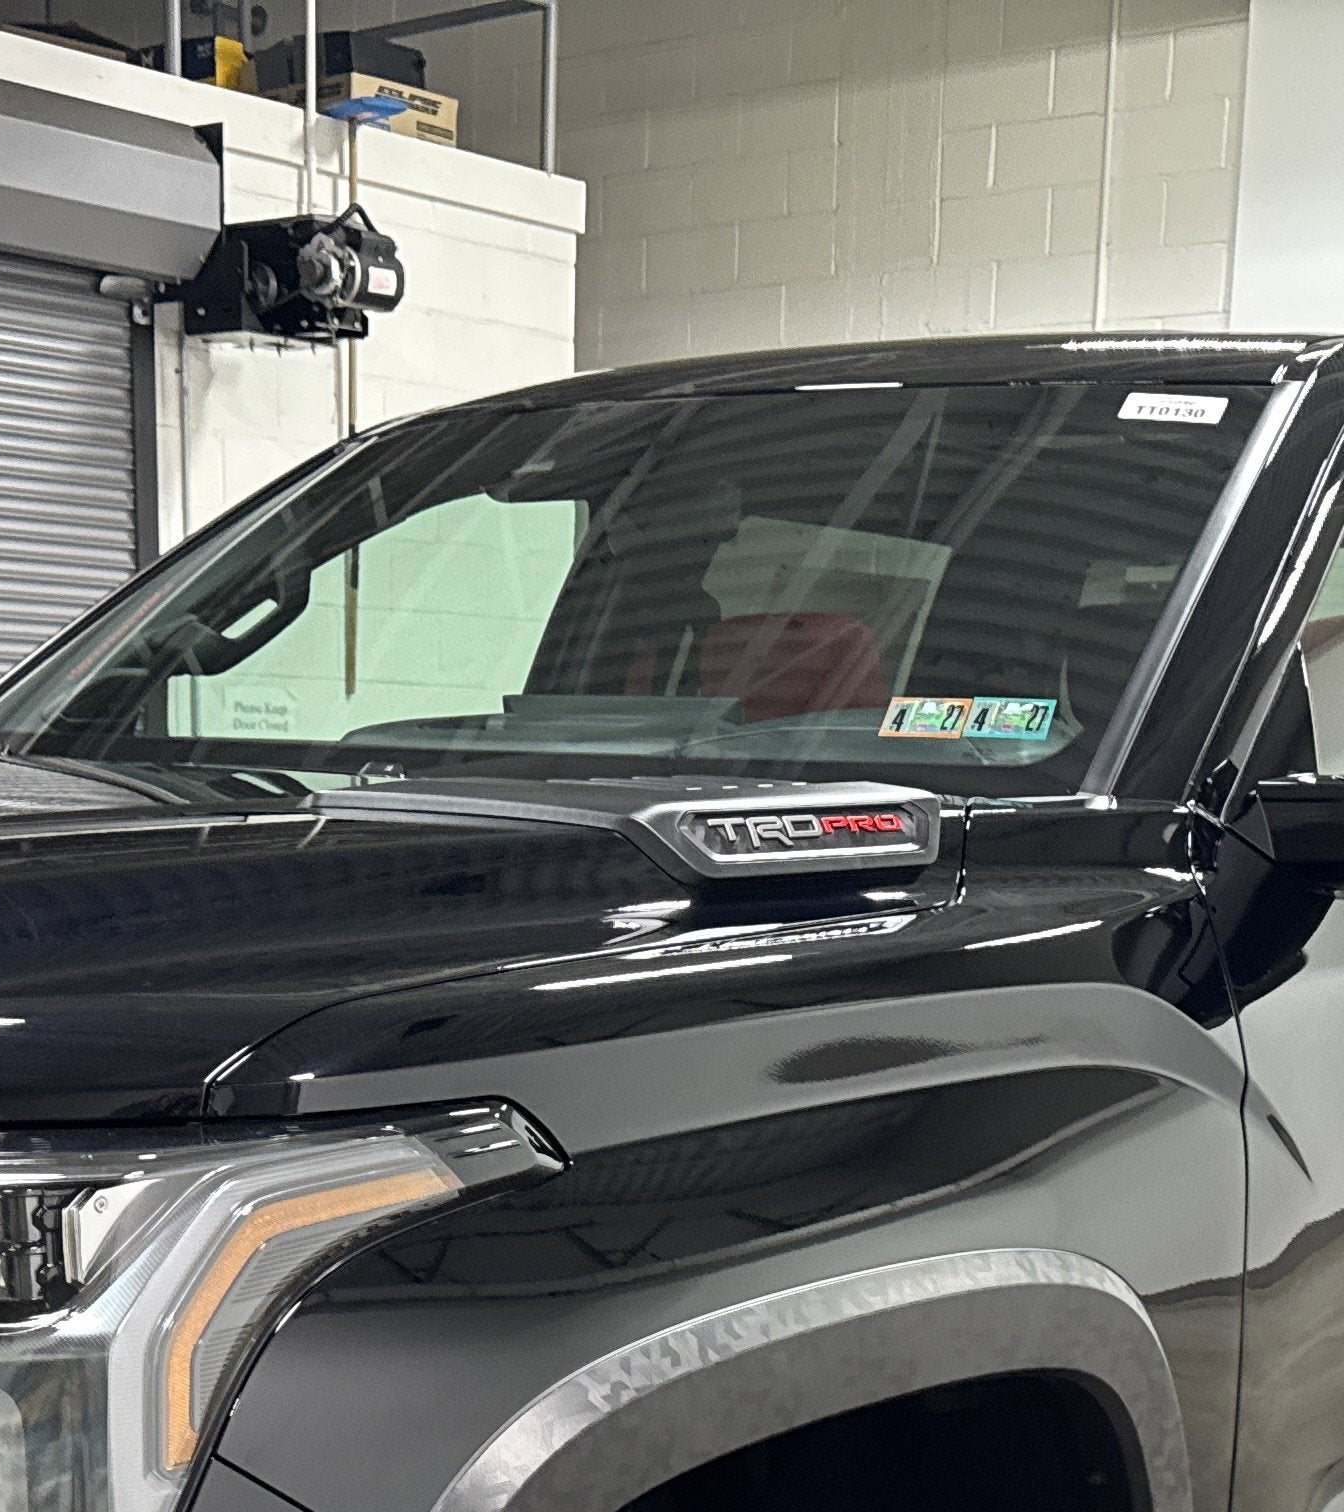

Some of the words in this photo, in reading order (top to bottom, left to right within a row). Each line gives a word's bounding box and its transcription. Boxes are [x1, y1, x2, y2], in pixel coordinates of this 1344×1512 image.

[892, 708, 907, 732] 4
[940, 704, 965, 730] 27
[973, 708, 989, 731] 4
[1024, 704, 1050, 731] 27
